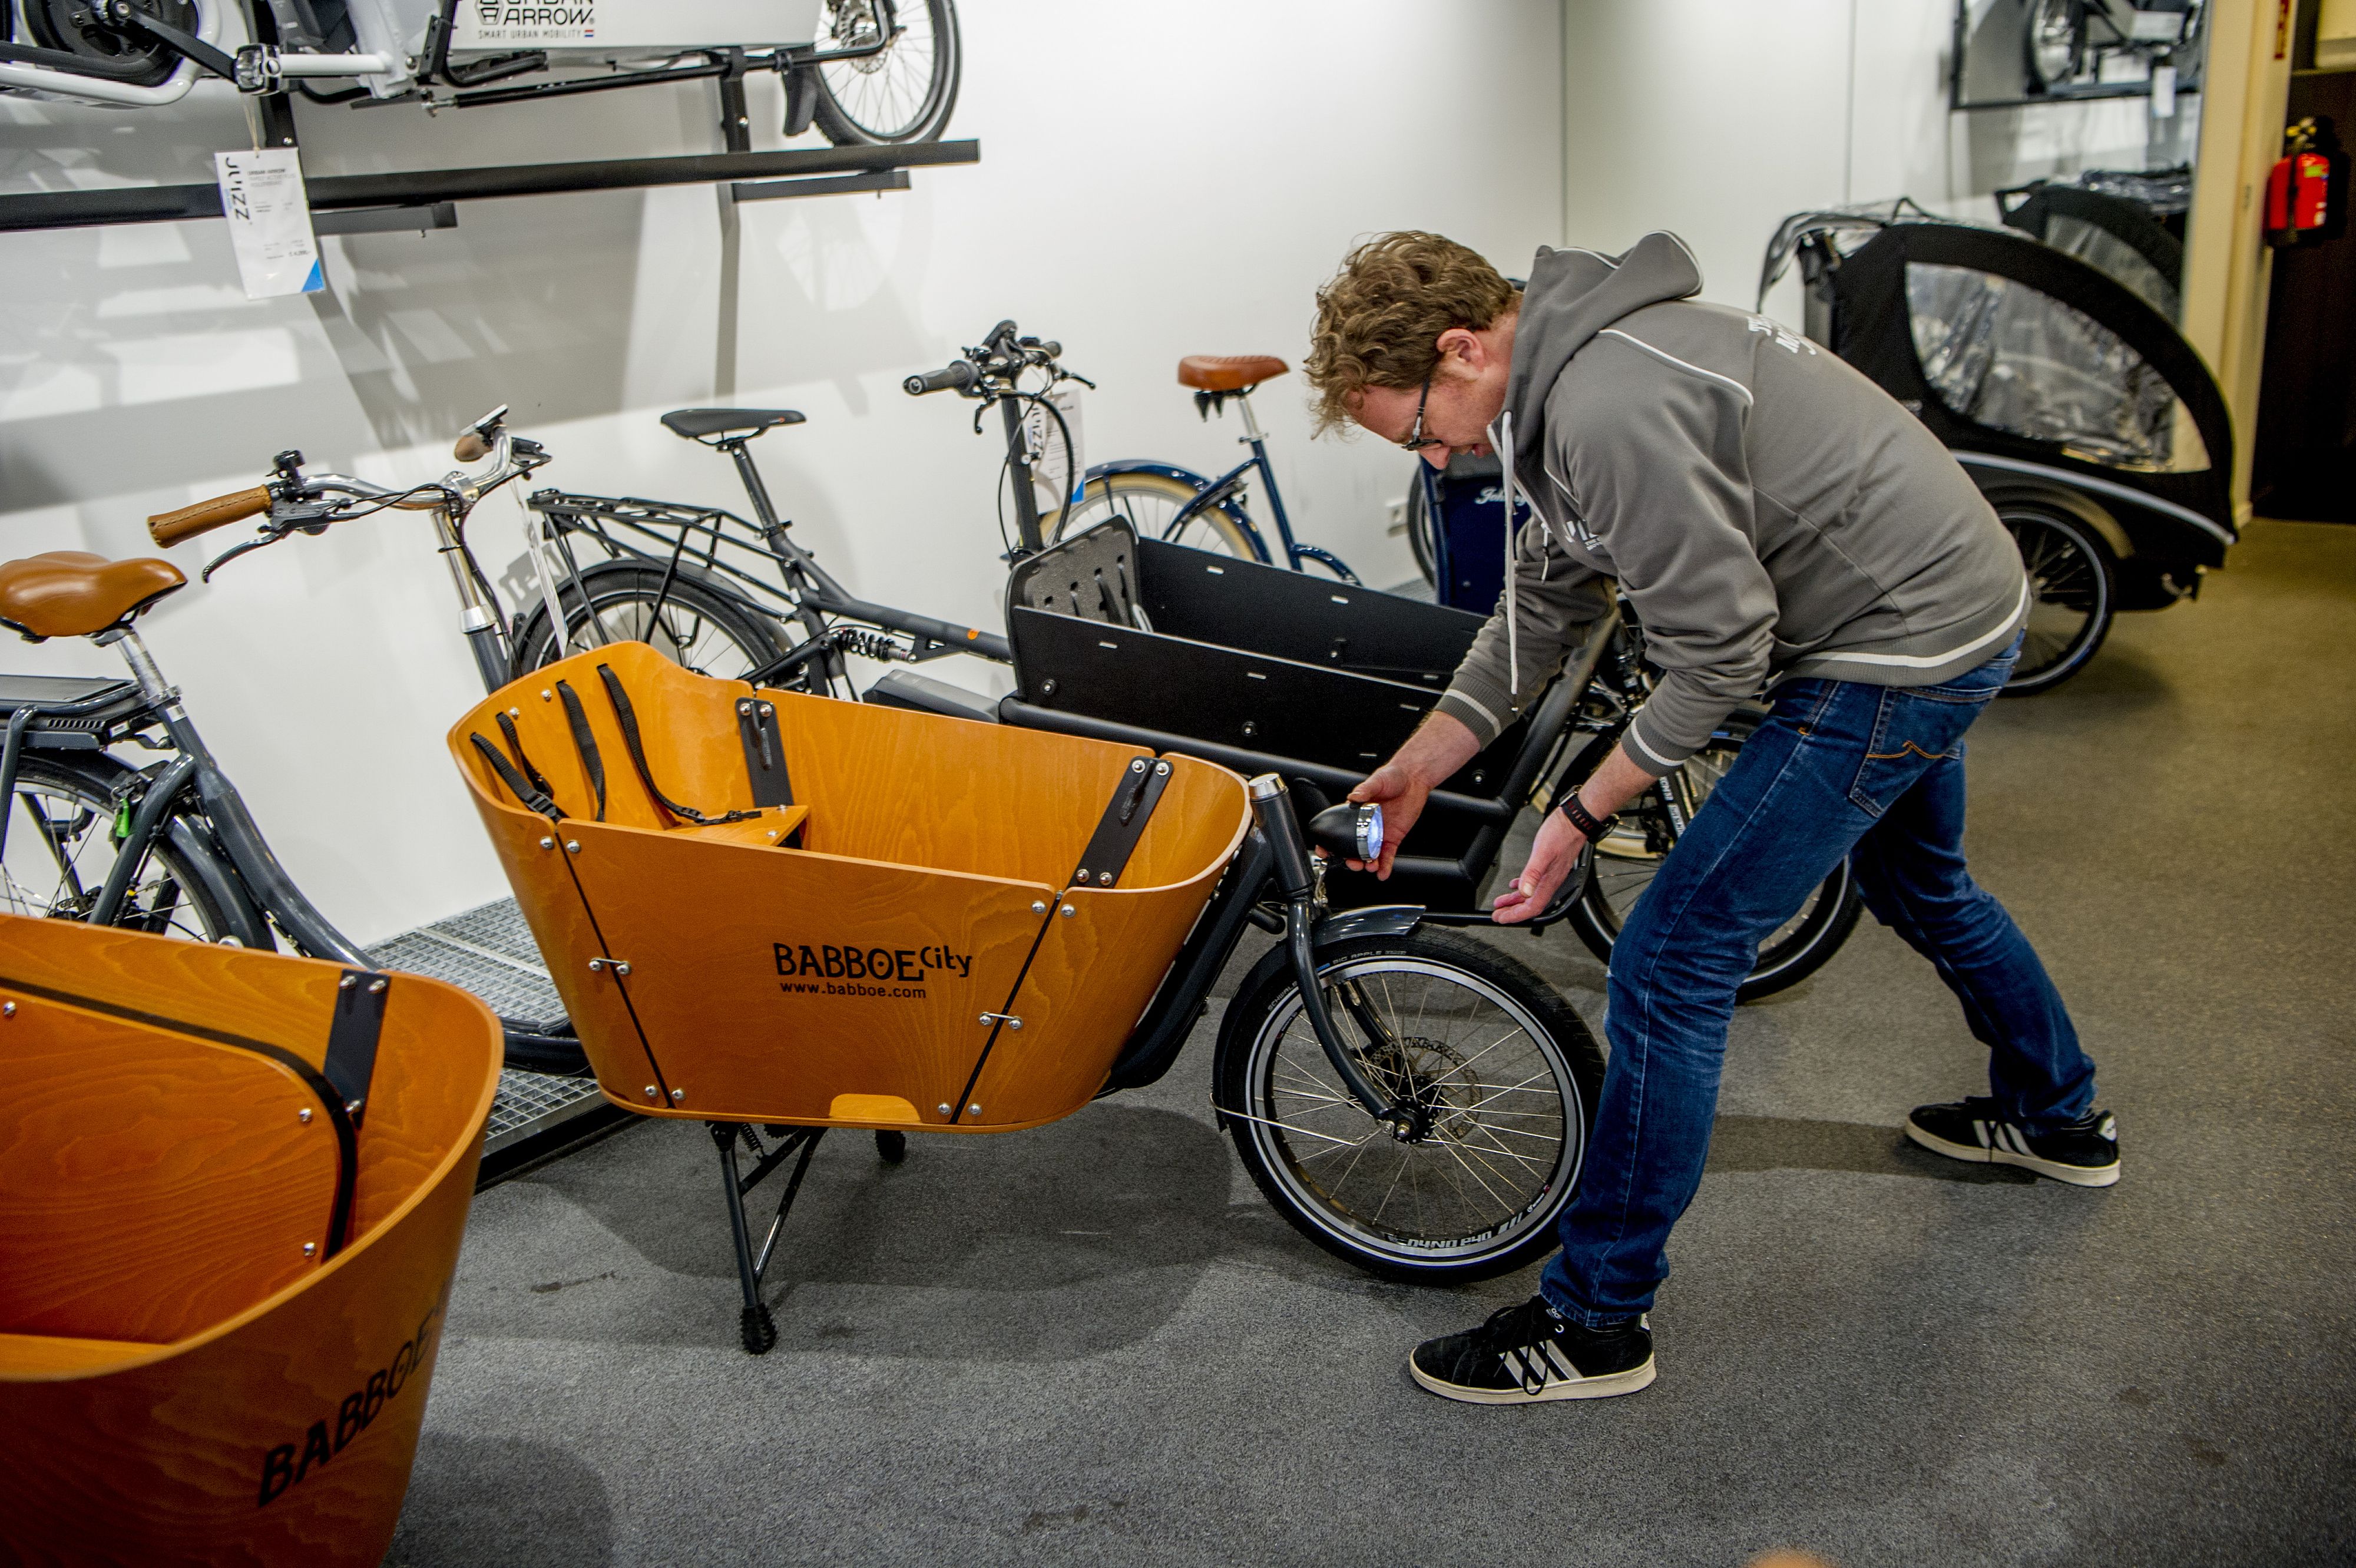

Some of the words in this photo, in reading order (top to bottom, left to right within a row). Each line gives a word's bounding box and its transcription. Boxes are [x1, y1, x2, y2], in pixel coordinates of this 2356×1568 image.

[504, 8, 593, 25] ARROW
[478, 30, 506, 39] SMART
[511, 30, 538, 39] URBAN
[542, 29, 581, 38] MOBILITY
[773, 942, 924, 981] BABBOE
[1351, 950, 1382, 960] APPLE
[780, 982, 926, 998] www.babboe.com
